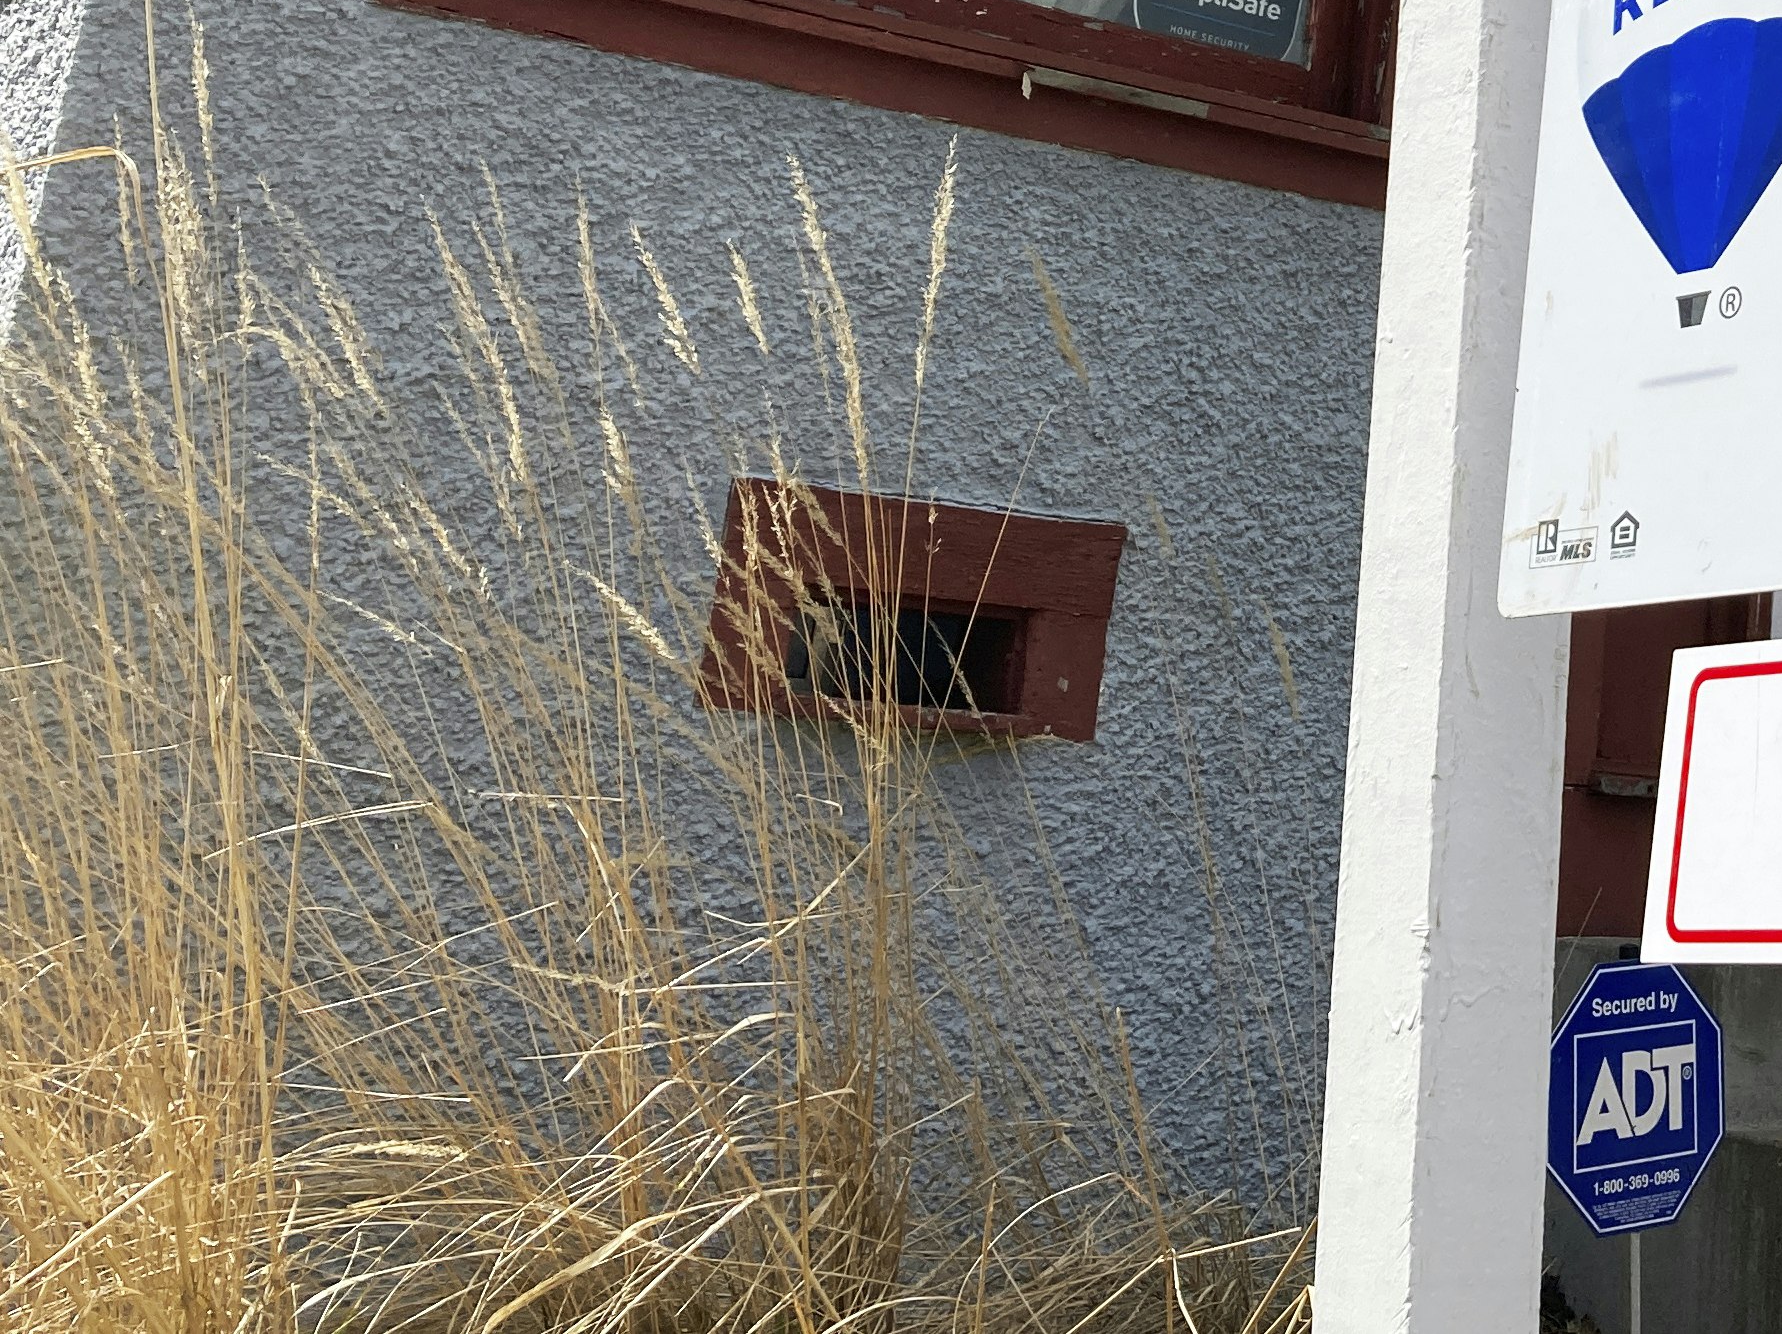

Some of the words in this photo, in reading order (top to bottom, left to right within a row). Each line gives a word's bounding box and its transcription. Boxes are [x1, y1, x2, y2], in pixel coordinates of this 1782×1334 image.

[1169, 24, 1197, 39] HOME
[1201, 32, 1250, 51] SECURITY
[1559, 541, 1593, 561] MLS
[1592, 992, 1656, 1017] Secured
[1660, 991, 1679, 1012] by
[1576, 1043, 1694, 1147] ADT
[1593, 1168, 1680, 1196] 1-800-369-0996
